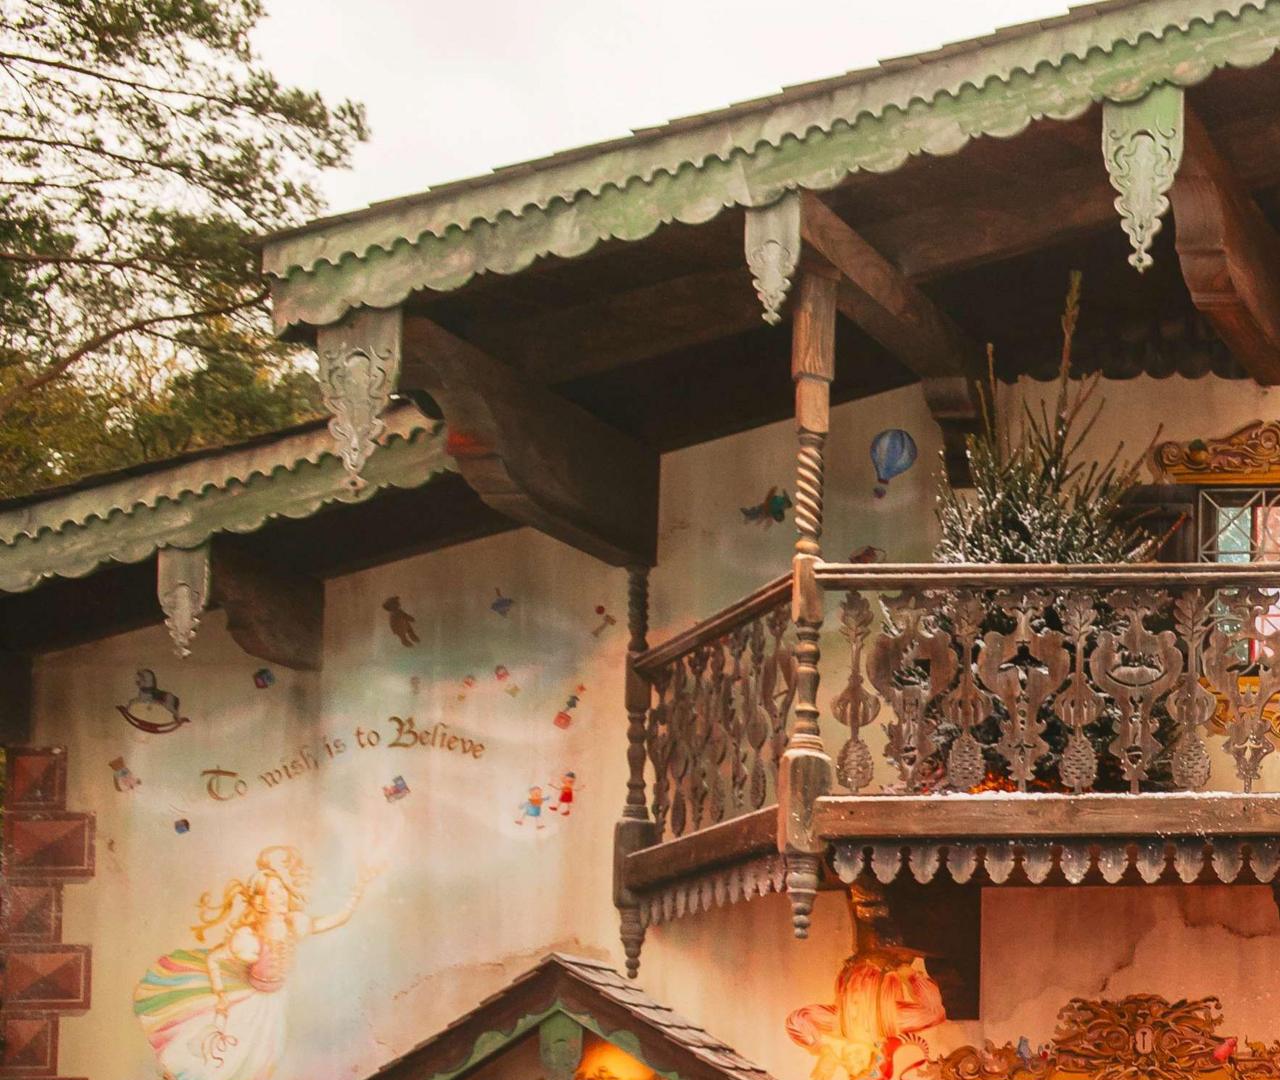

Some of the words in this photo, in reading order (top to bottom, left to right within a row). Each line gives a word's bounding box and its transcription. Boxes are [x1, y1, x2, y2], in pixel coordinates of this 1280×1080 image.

[200, 764, 248, 801] To
[258, 746, 319, 788] wish
[324, 734, 346, 758] is
[354, 726, 380, 750] to
[387, 716, 485, 759] Believe
